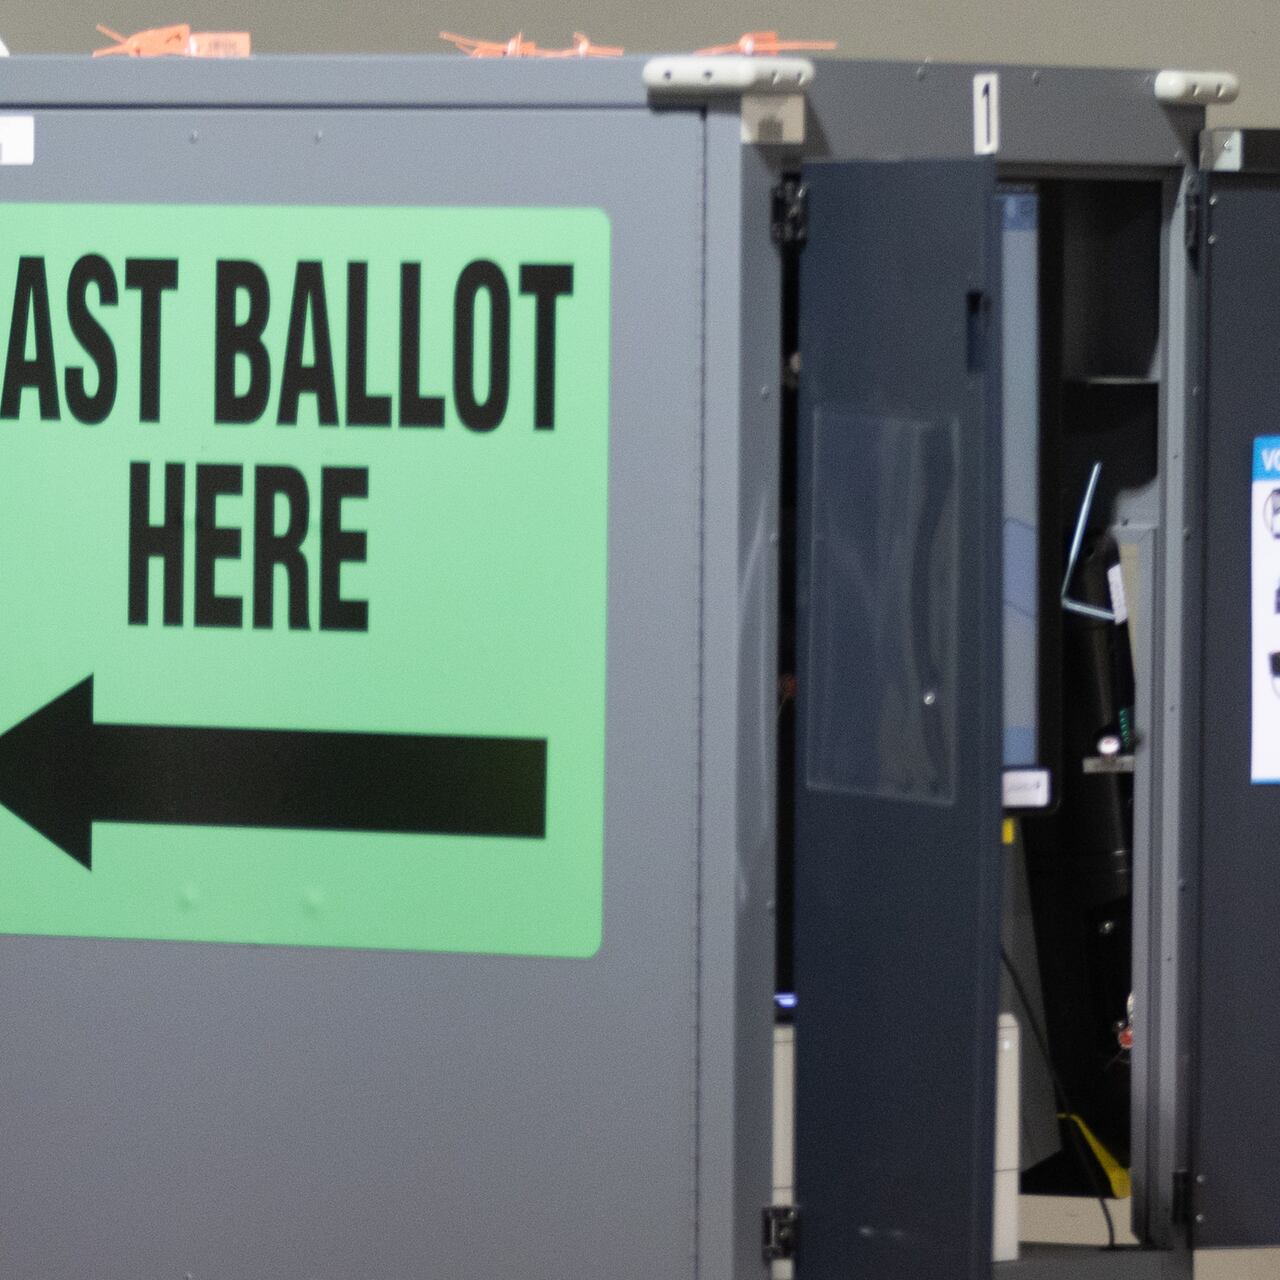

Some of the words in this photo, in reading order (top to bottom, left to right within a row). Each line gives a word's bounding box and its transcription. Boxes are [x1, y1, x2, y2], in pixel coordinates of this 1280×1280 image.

[982, 82, 991, 145] 1
[213, 258, 575, 433] BALLOT
[127, 460, 370, 633] HERE
